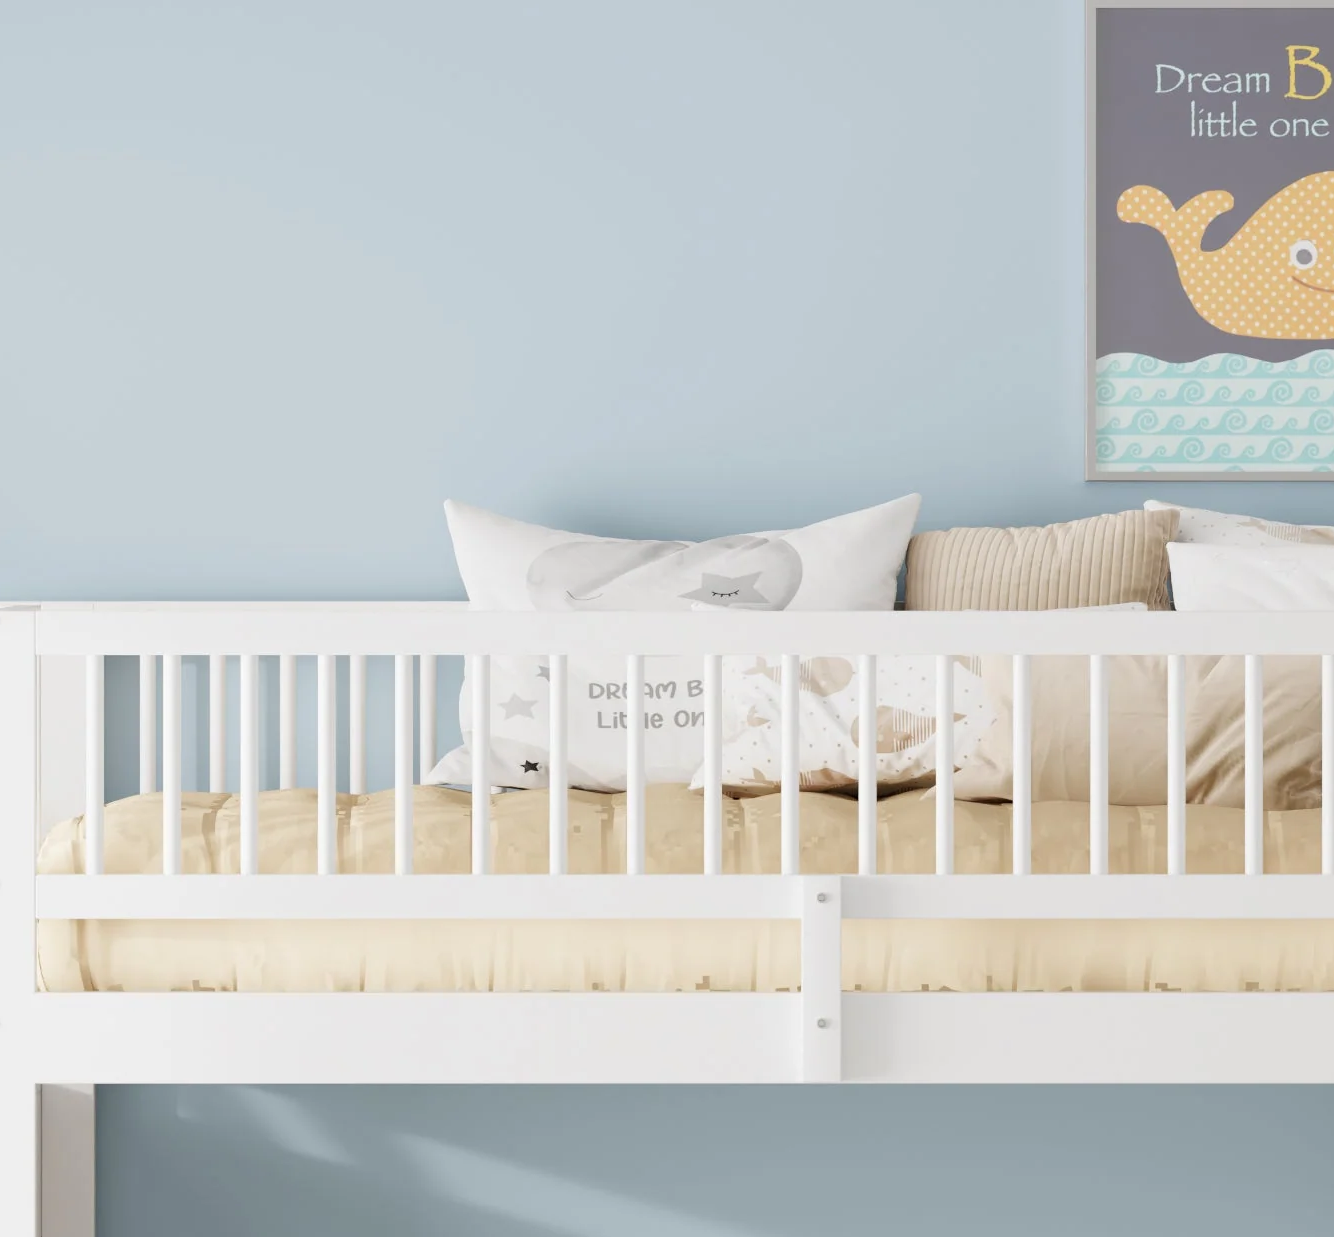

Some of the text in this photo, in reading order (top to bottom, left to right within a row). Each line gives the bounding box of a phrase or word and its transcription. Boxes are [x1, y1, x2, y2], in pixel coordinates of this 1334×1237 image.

[1154, 63, 1271, 94] Dream
[1190, 100, 1331, 138] little one
[597, 711, 664, 729] Litle
